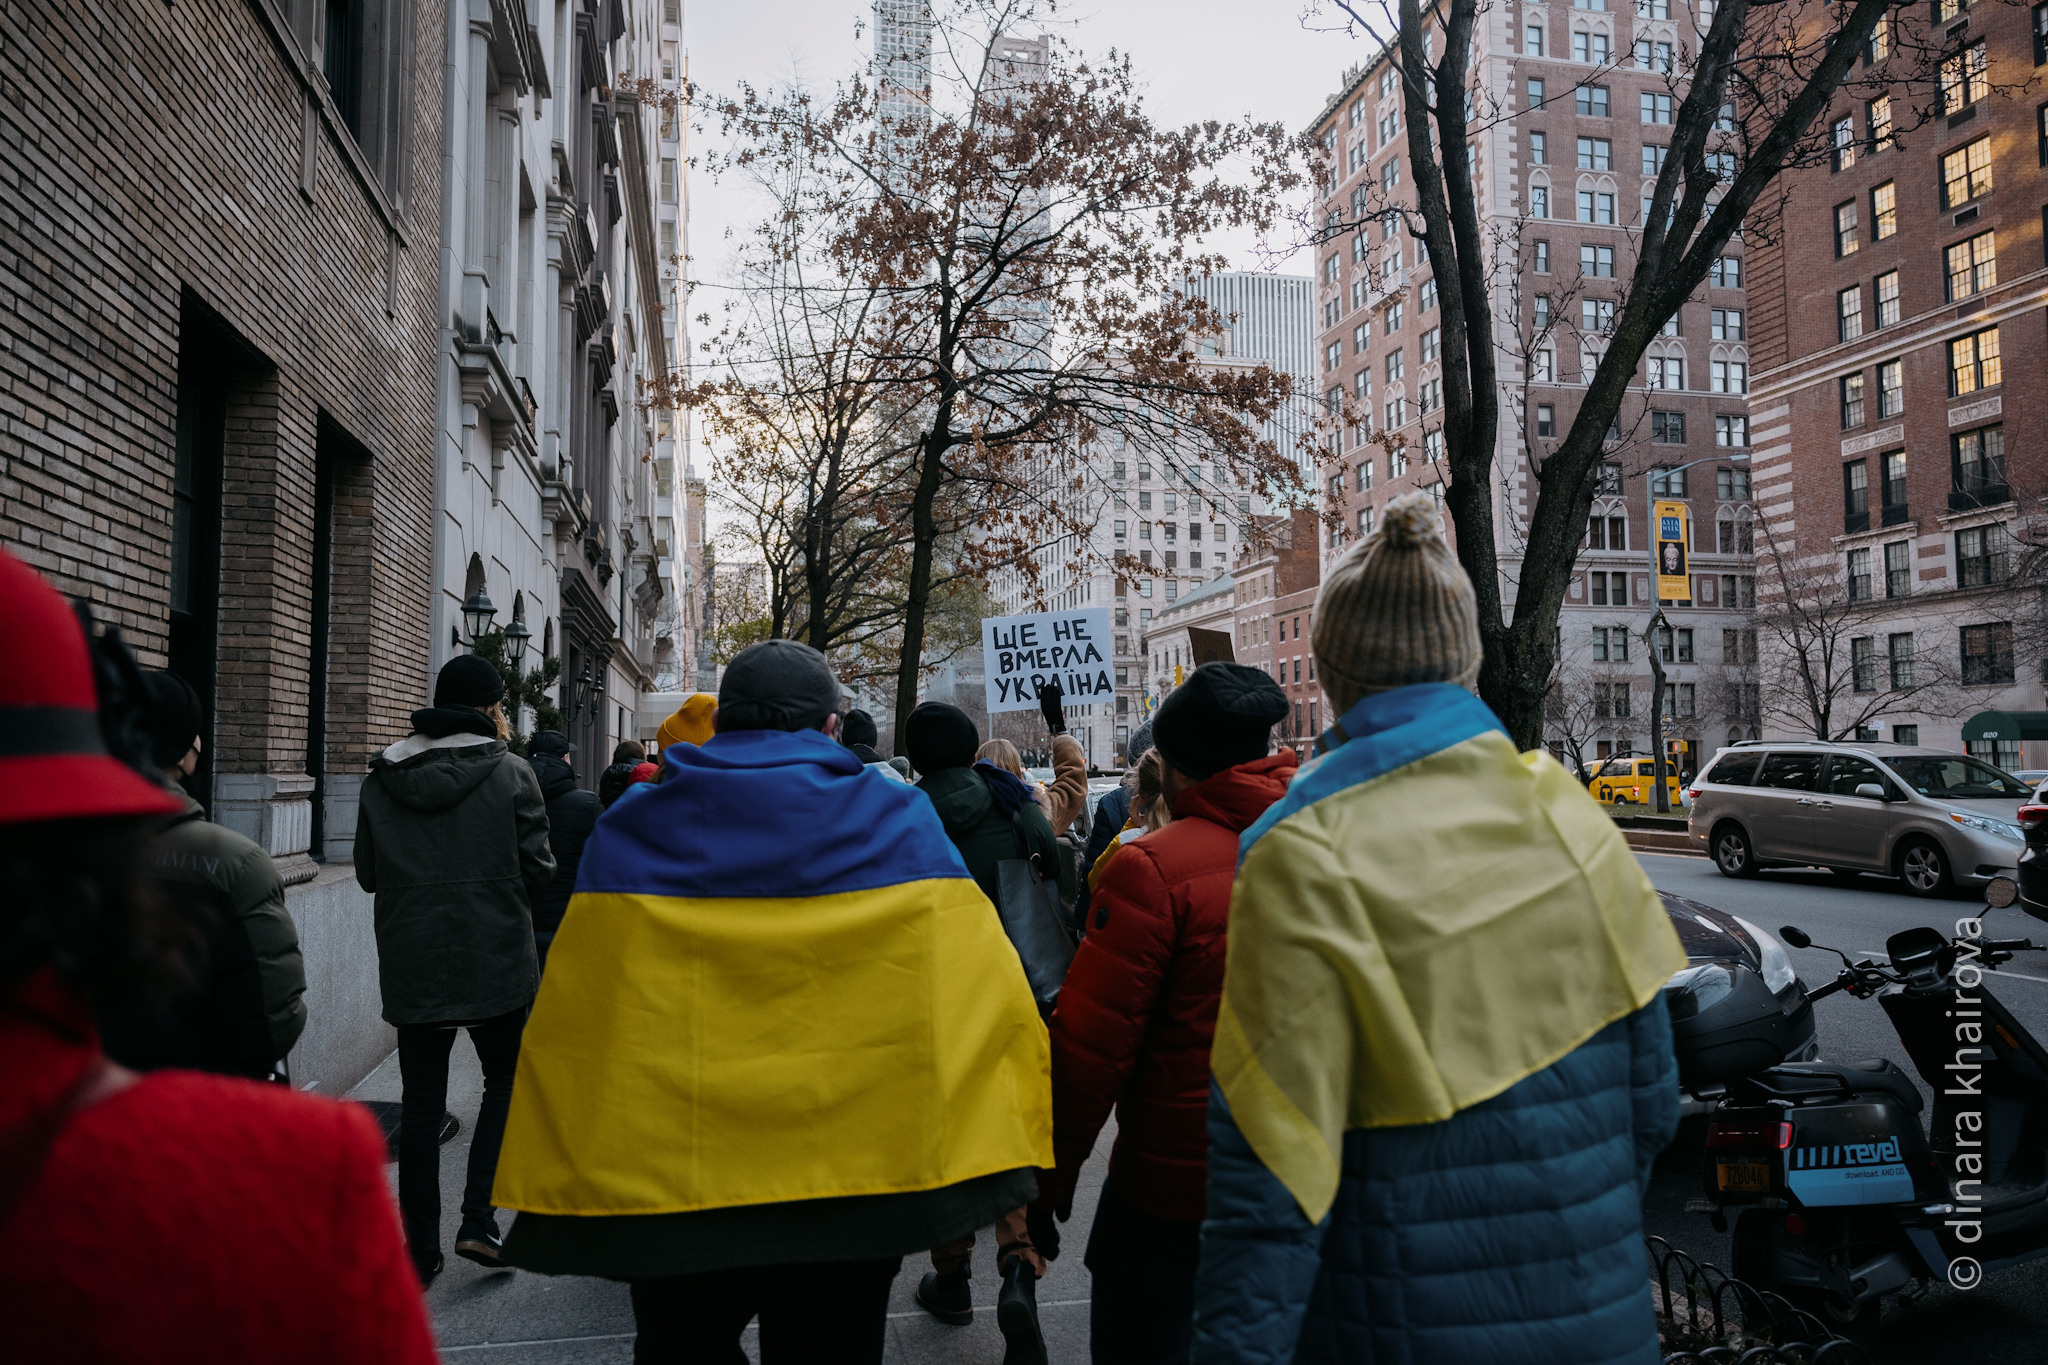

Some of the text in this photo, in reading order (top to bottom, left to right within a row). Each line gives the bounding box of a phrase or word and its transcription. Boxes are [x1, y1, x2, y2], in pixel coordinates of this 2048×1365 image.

[993, 618, 1092, 650] ЩЕ НЕ
[998, 642, 1104, 675] ВМЕРЛА
[1843, 1135, 1903, 1165] revel
[1881, 1168, 1895, 1177] AND
